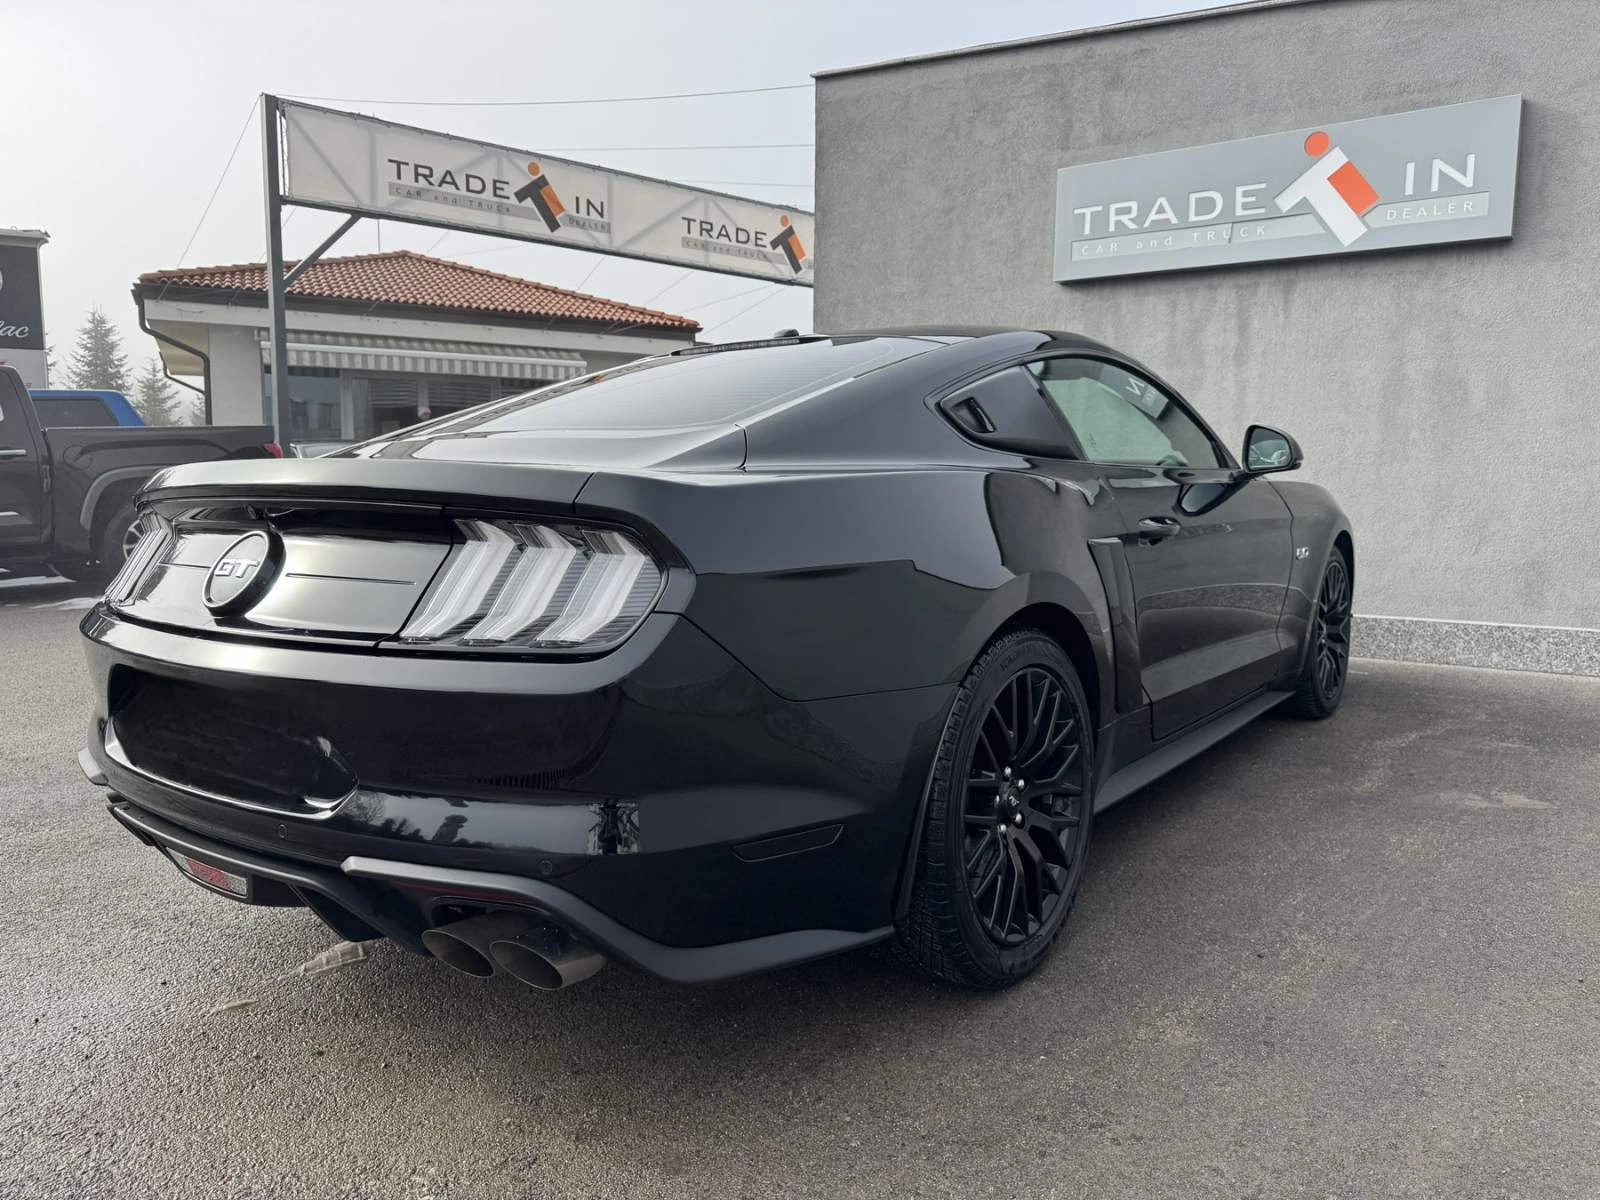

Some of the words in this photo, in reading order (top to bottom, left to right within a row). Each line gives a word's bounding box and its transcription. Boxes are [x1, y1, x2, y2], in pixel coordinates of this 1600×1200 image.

[388, 158, 511, 200] TRADE
[575, 196, 604, 219] IN
[394, 187, 421, 198] CAR
[1073, 183, 1267, 235] TRADE
[1404, 154, 1475, 195] IN
[681, 216, 767, 248] TRADE
[1081, 242, 1118, 256] CAR
[1136, 236, 1173, 249] and
[1192, 225, 1266, 242] TRUCK
[1386, 200, 1474, 220] DEALER
[215, 558, 260, 578] GT
